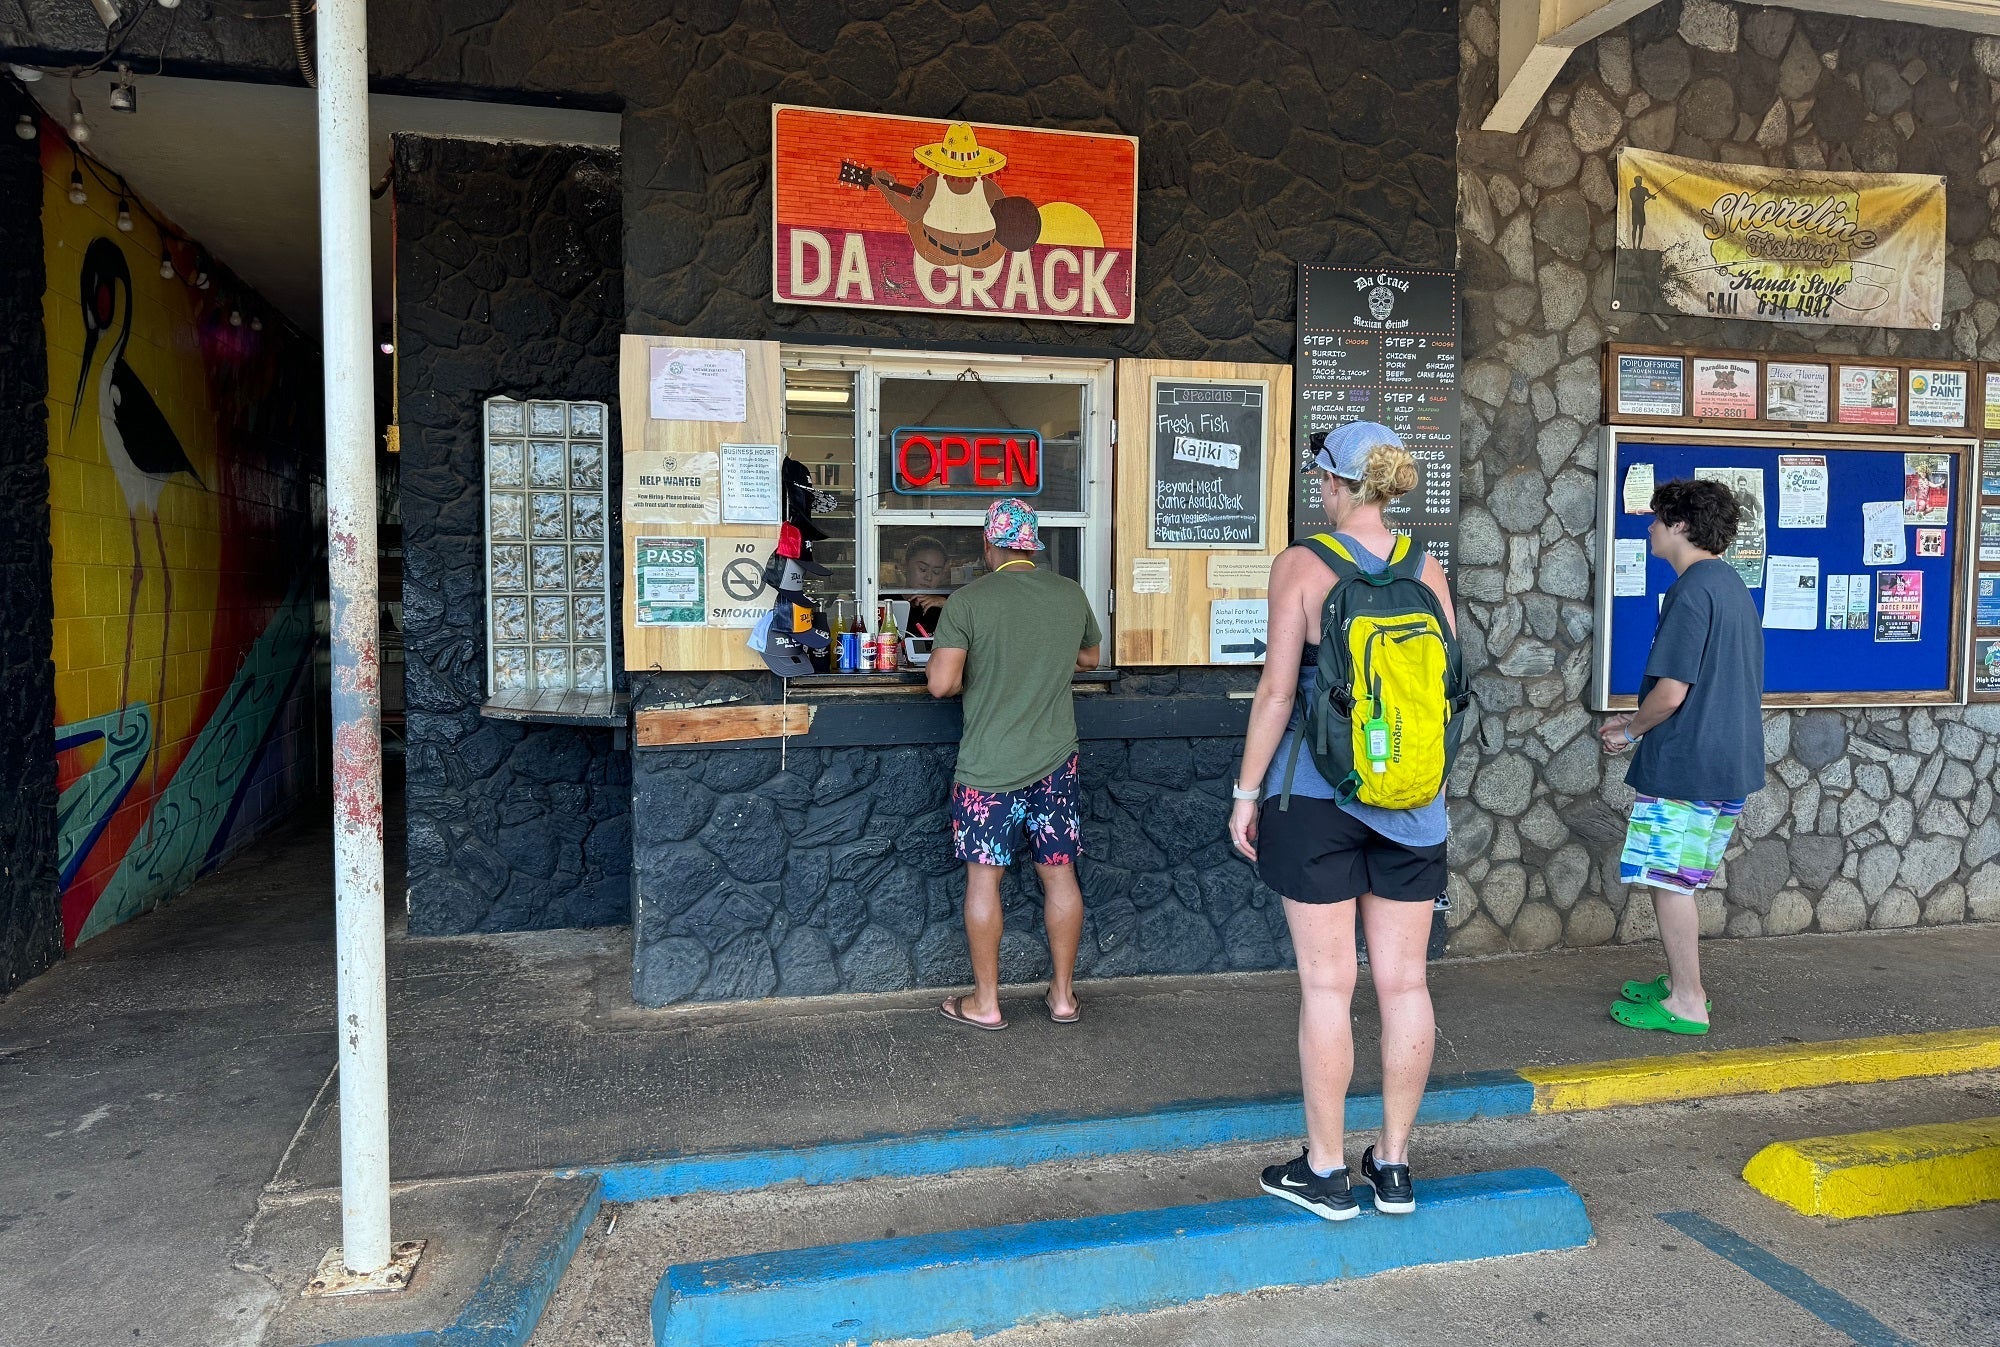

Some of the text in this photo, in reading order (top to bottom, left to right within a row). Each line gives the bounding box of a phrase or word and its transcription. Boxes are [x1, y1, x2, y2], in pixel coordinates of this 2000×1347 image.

[1700, 191, 1878, 250] Shoreline
[1745, 229, 1840, 269] Fishing
[790, 228, 1120, 316] DA CRACK
[1353, 273, 1410, 293] Da Crack
[1729, 269, 1847, 297] Kauai Style
[1353, 315, 1409, 330] Mexican Grinds
[1303, 335, 1334, 346] STEP
[1337, 336, 1342, 347] 1
[1385, 337, 1415, 348] STEP
[1418, 338, 1427, 348] 2
[1312, 350, 1347, 358] BURRITO
[1385, 352, 1417, 360] CHICKEN
[1385, 361, 1406, 369] PORK
[1643, 360, 1680, 369] OFFSHORE
[1700, 363, 1750, 375] Paradise Bloom
[1793, 369, 1825, 384] Flooring
[1932, 373, 1959, 386] PUHI
[1302, 390, 1333, 401] STEP
[1337, 390, 1345, 401] 3
[1700, 390, 1738, 398] Landscaping,
[1930, 385, 1962, 398] PAINT
[1384, 392, 1413, 403] STEP
[1417, 393, 1426, 404] 4
[1346, 405, 1366, 413] RICE
[1701, 406, 1747, 418] 332-8801
[1311, 413, 1338, 421] BROWN
[1158, 413, 1230, 434] Fresh Fish
[1394, 423, 1411, 431] LAVA
[1175, 438, 1222, 462] Kajiki
[1409, 450, 1446, 461] RICES
[898, 435, 1037, 487] OPEN
[1426, 462, 1451, 470] $13.49
[1426, 471, 1451, 479] $13.95
[640, 475, 701, 487] HELP WANTED
[1157, 476, 1223, 496] Beyond Meat
[1425, 479, 1451, 488] $14.49
[1791, 474, 1818, 488] Limu
[1425, 488, 1451, 496] $14.49
[1188, 493, 1217, 510] Asada
[1425, 497, 1451, 505] $16.95
[1425, 506, 1451, 514] $15.95
[1156, 512, 1180, 527] Fajita
[1223, 525, 1252, 541] Bowl
[1386, 528, 1412, 538] ENU
[735, 543, 756, 553] NO
[1427, 540, 1450, 548] $7.95
[646, 549, 696, 563] PASS
[712, 608, 767, 618] SMOKIN
[1215, 618, 1235, 626] Safety,
[1224, 627, 1251, 635] Sidewalk,
[775, 637, 790, 646] Da
[1976, 676, 1990, 684] High
[1392, 706, 1404, 764] patagonia
